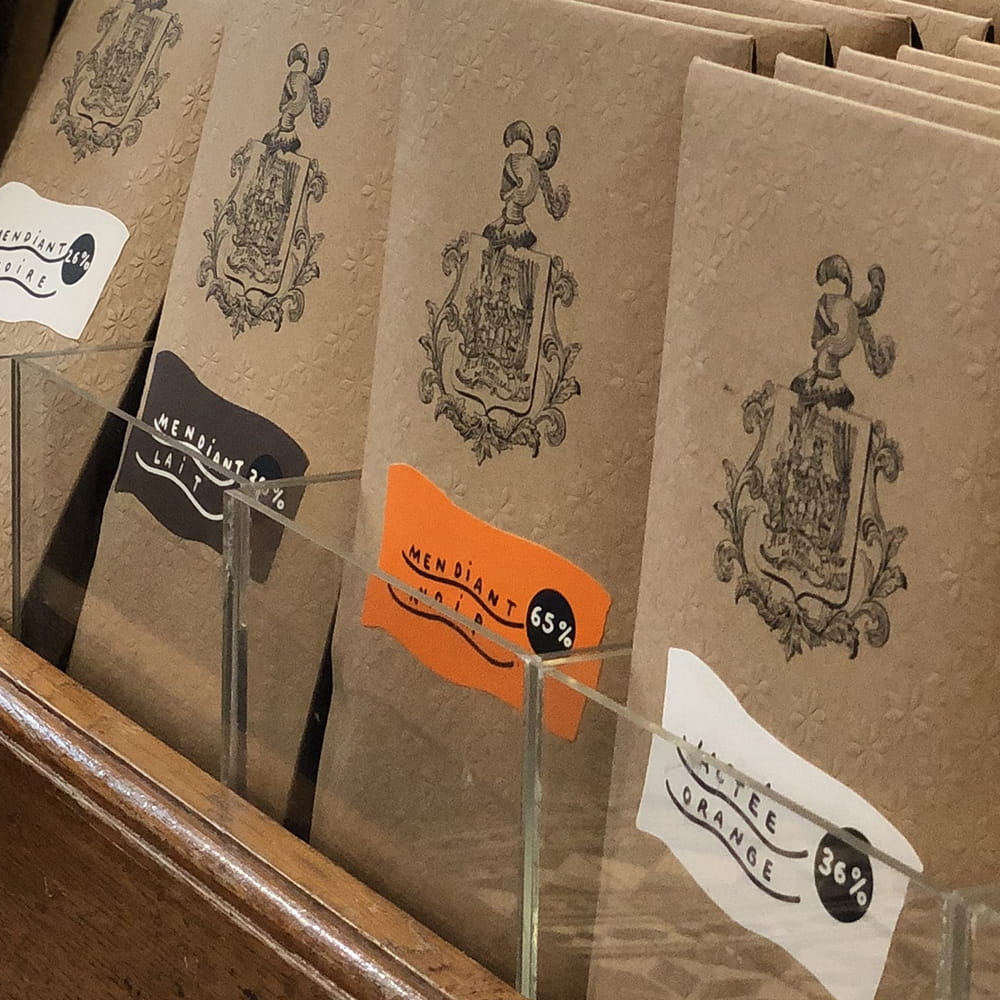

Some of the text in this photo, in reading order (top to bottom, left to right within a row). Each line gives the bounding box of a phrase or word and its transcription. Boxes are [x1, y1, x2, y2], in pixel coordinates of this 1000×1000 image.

[65, 249, 90, 271] 26%
[530, 606, 573, 649] 65%
[682, 786, 774, 882] ORANGE
[817, 847, 868, 906] 36%
